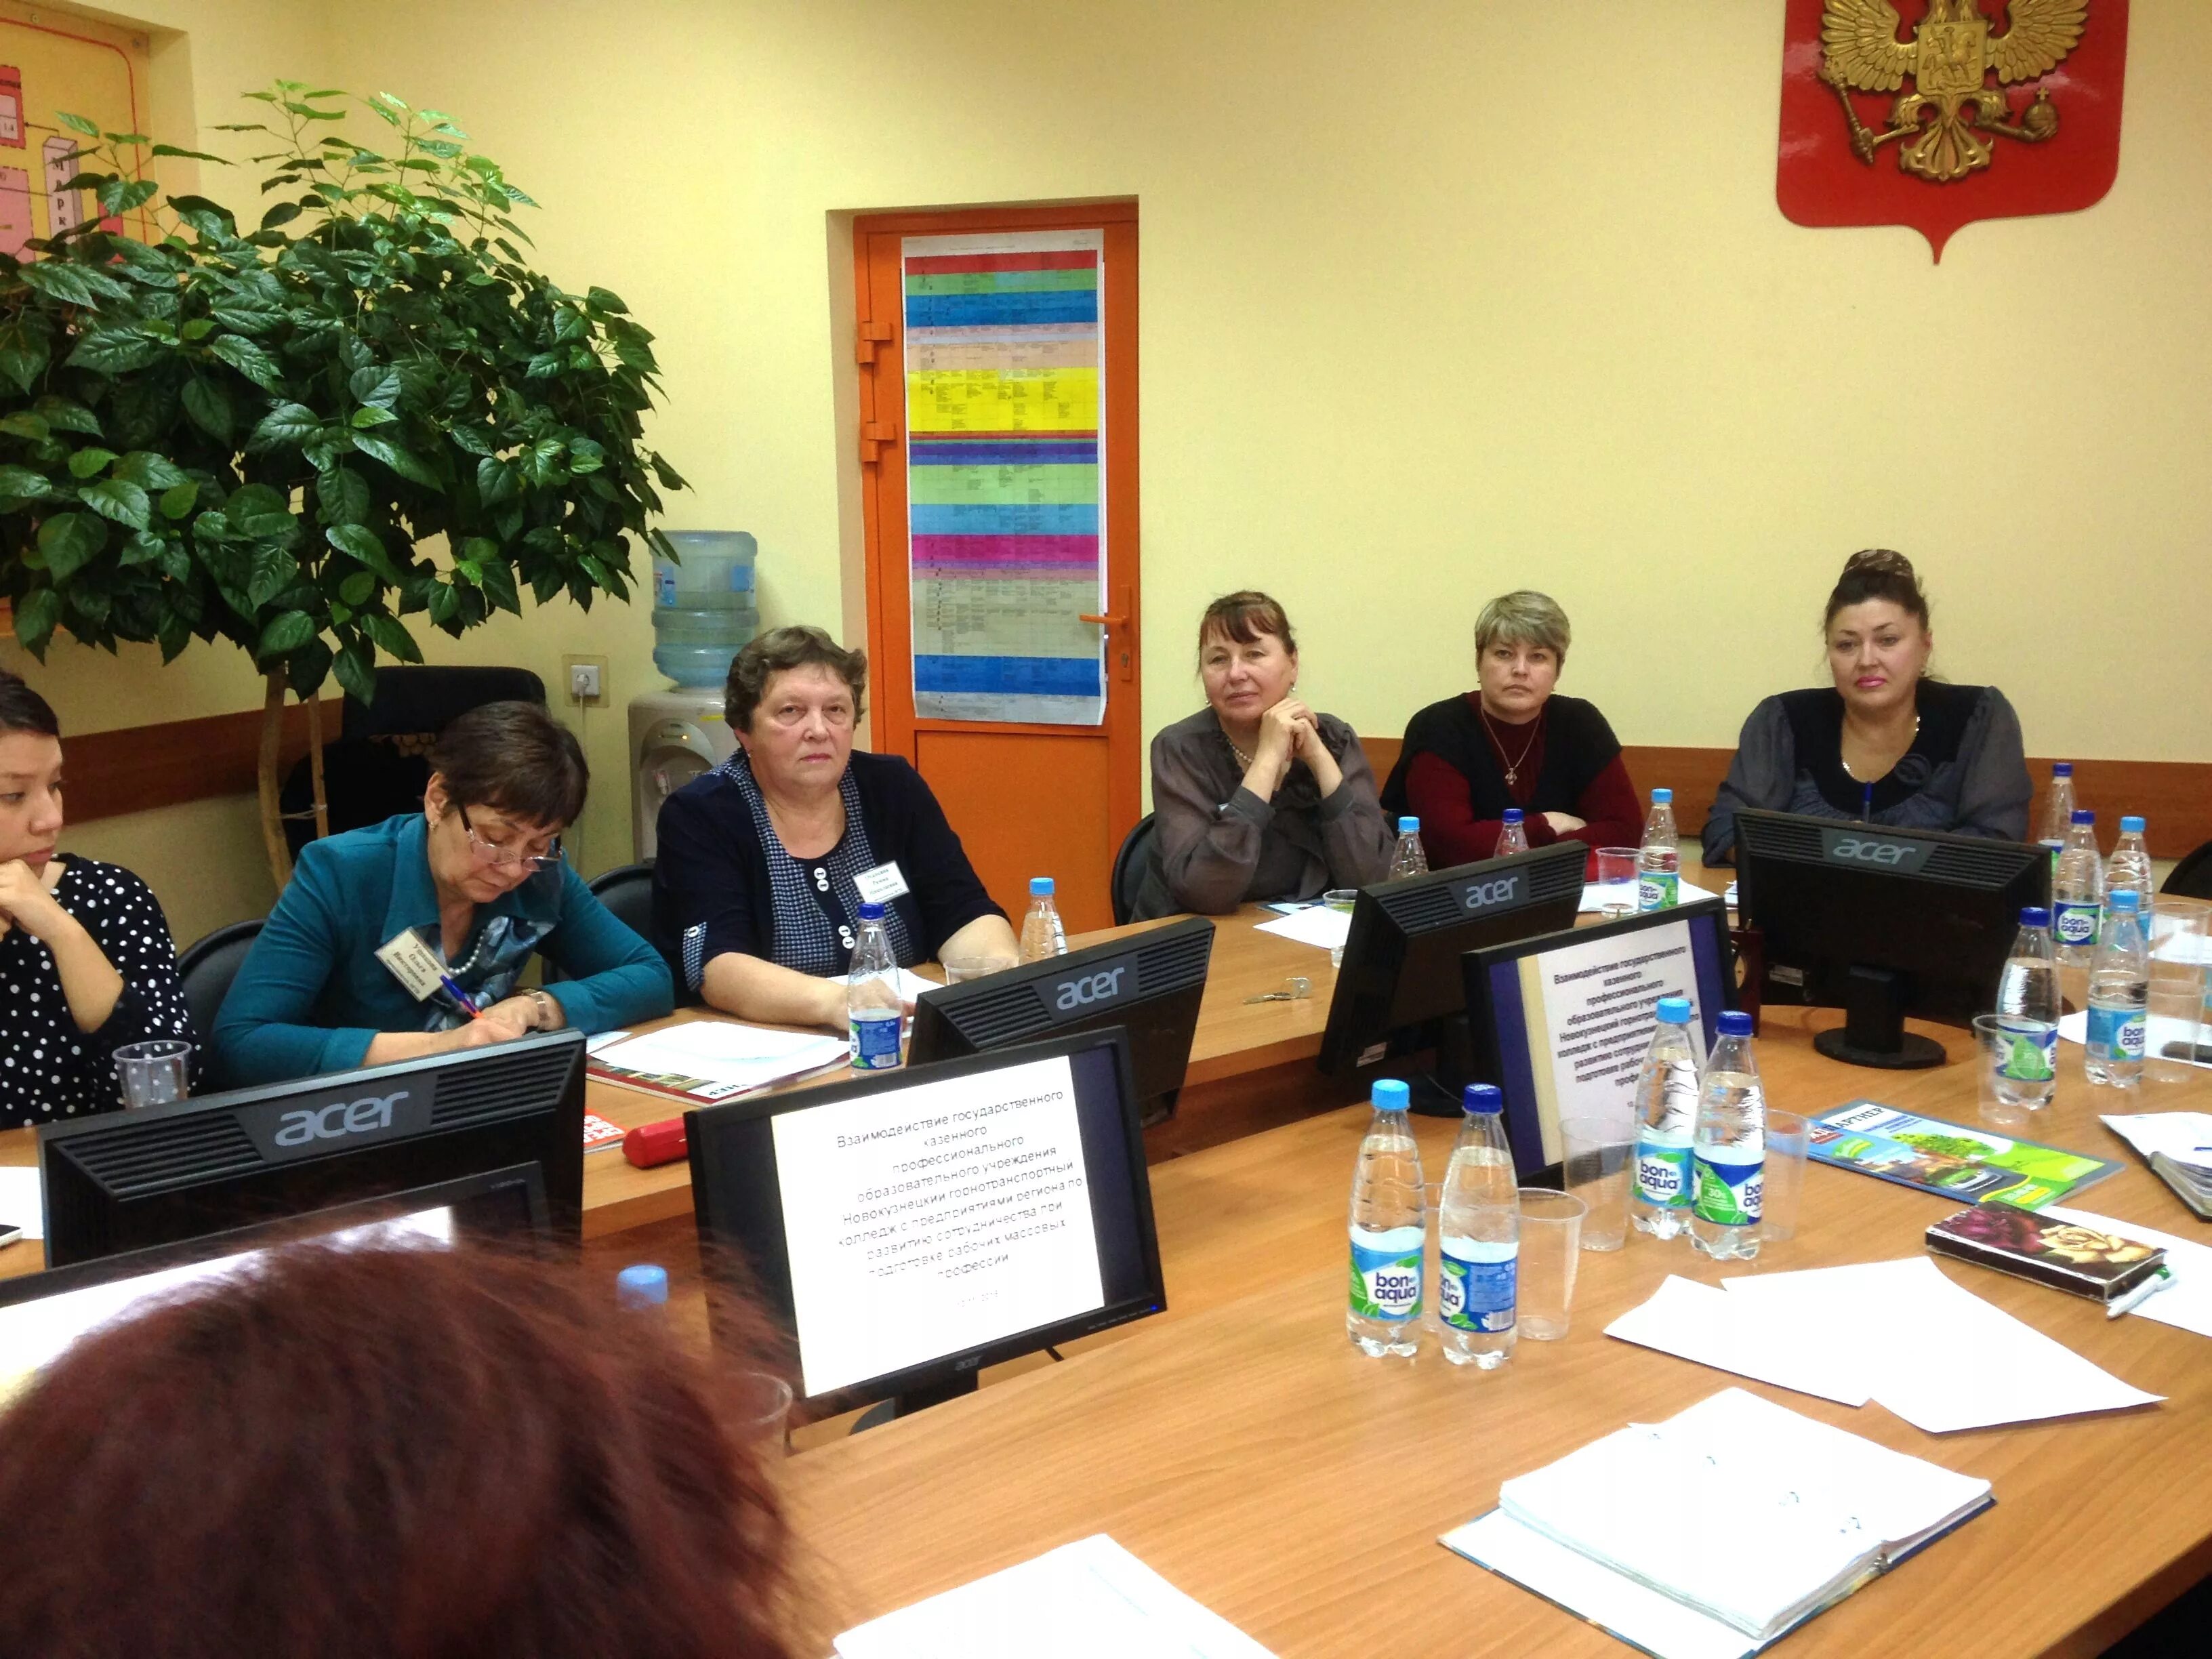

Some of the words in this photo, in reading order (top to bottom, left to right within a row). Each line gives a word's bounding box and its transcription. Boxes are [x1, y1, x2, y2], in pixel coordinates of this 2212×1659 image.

[1833, 838, 1916, 865] acer
[1466, 877, 1519, 909] acer
[2061, 923, 2089, 937] aqua
[1056, 966, 1125, 1010] acer
[2122, 1036, 2145, 1048] aqu
[274, 1090, 409, 1147] acer
[953, 1090, 1063, 1122] государственного
[924, 1126, 987, 1147] казенного
[893, 1135, 1025, 1173] профессионального
[857, 1164, 979, 1203] образовательного
[983, 1147, 1057, 1176] учреждения
[949, 1160, 1074, 1199] горнотранспортный
[1639, 1174, 1679, 1190] aqua
[838, 1225, 897, 1247] колледж
[901, 1221, 908, 1231] с
[912, 1195, 1013, 1227] предприятиями
[1017, 1181, 1065, 1202] региона
[1068, 1177, 1083, 1189] по
[867, 1235, 932, 1260] развитию
[937, 1208, 1037, 1242] сотрудничества
[1004, 1219, 1067, 1242] массовых
[1375, 1287, 1416, 1303] aqua
